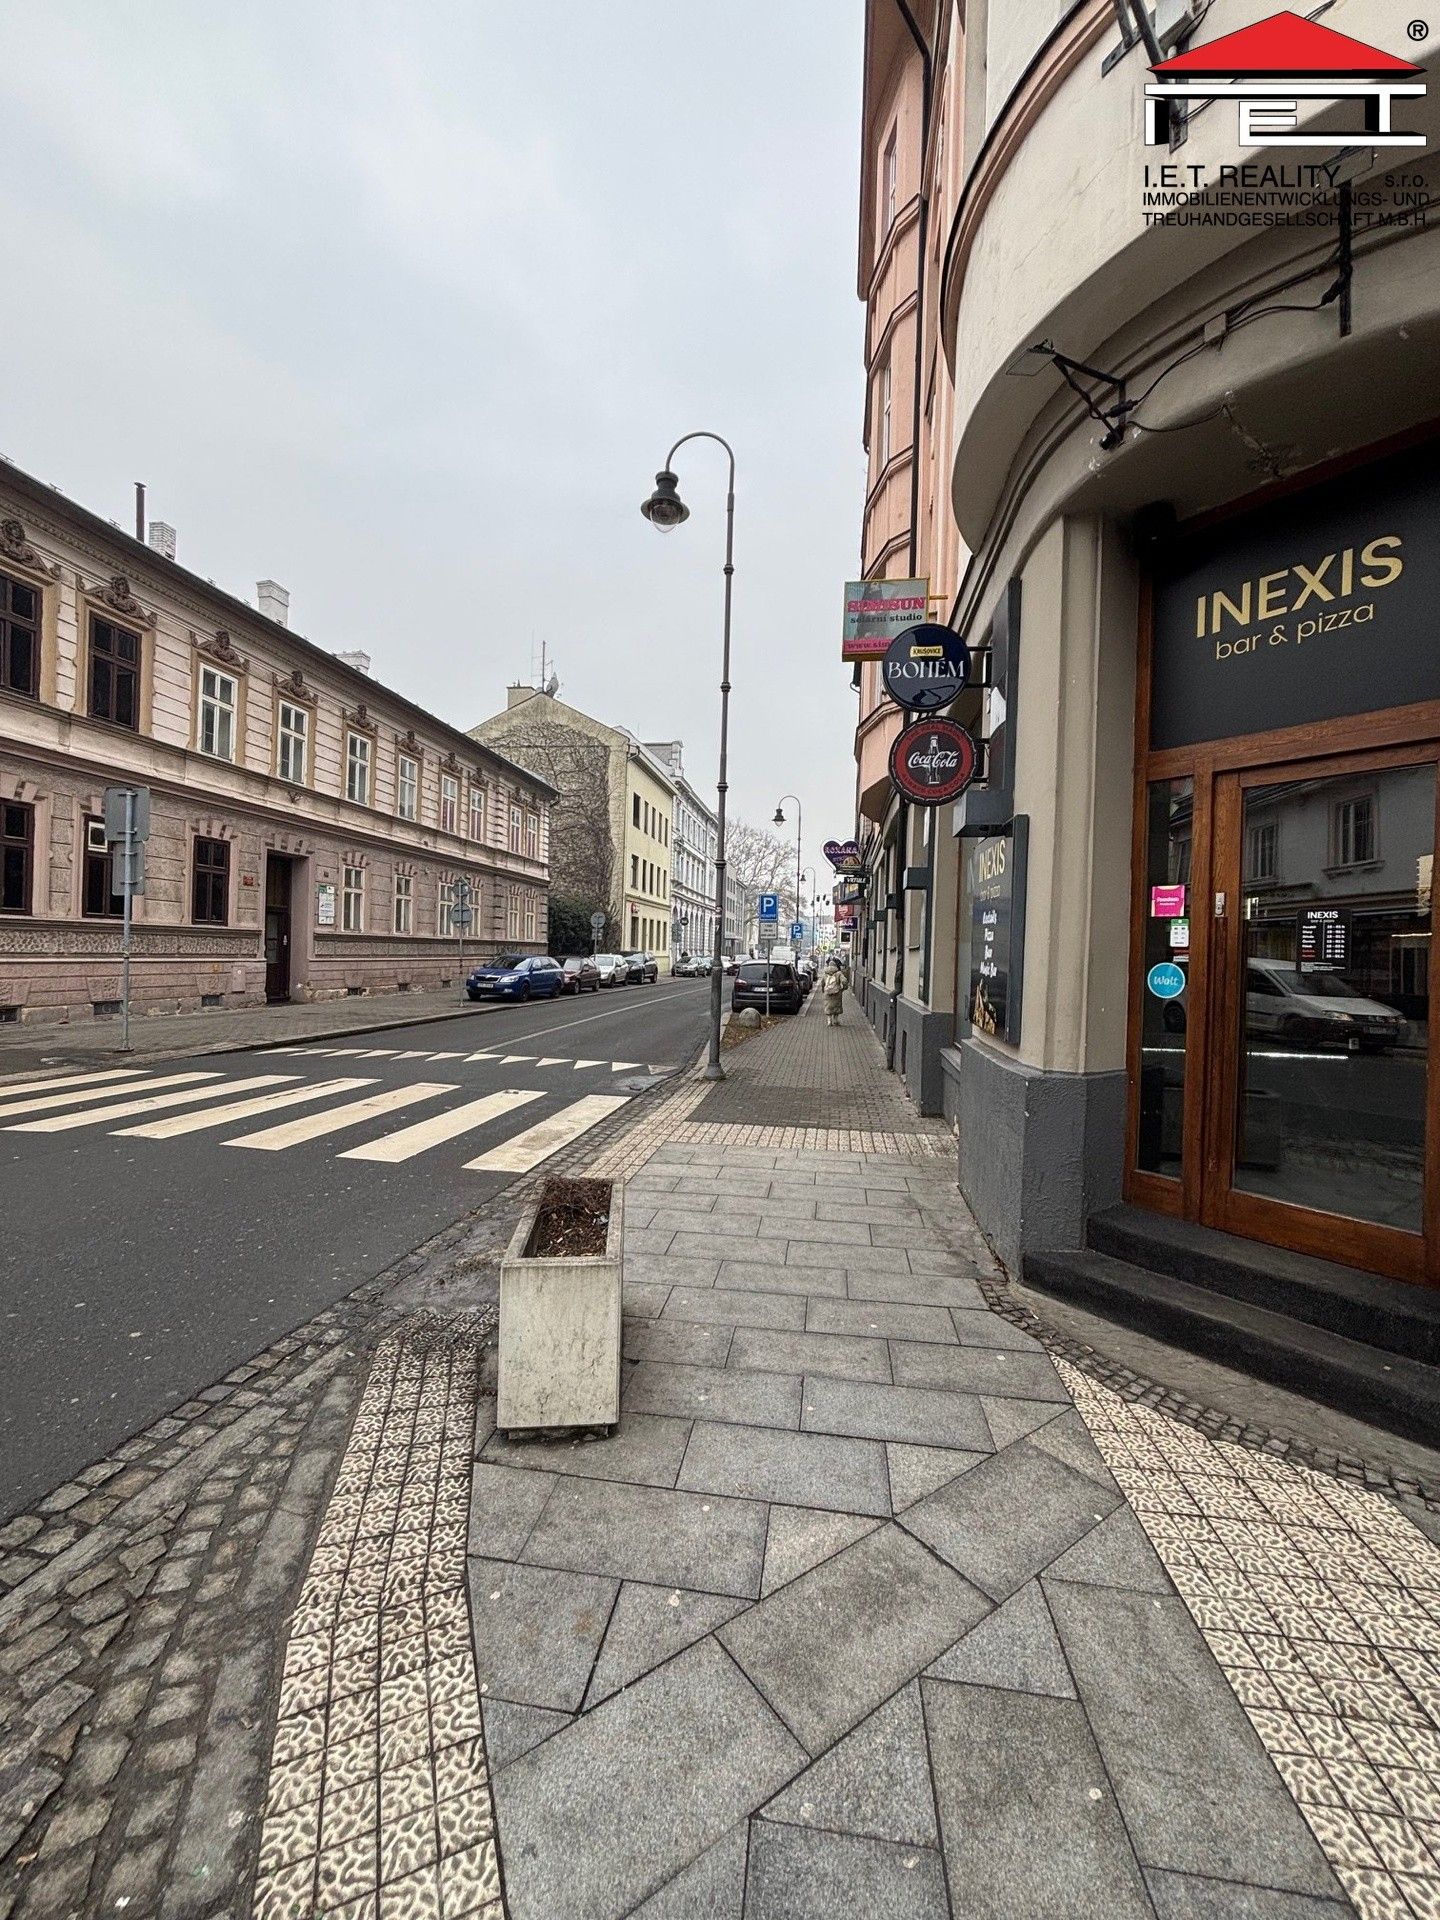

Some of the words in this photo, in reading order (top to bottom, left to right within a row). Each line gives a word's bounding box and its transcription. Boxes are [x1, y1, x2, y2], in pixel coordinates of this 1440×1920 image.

[1196, 535, 1403, 638] INEXIS
[889, 613, 923, 622] studio
[1216, 634, 1262, 660] bar
[1269, 625, 1288, 646] &
[1297, 603, 1374, 644] pizza
[888, 657, 965, 679] BOHÉM
[979, 839, 1006, 883] INEXIS
[763, 897, 775, 913] P
[1307, 911, 1339, 919] INEXIS
[1154, 975, 1179, 986] Wolt
